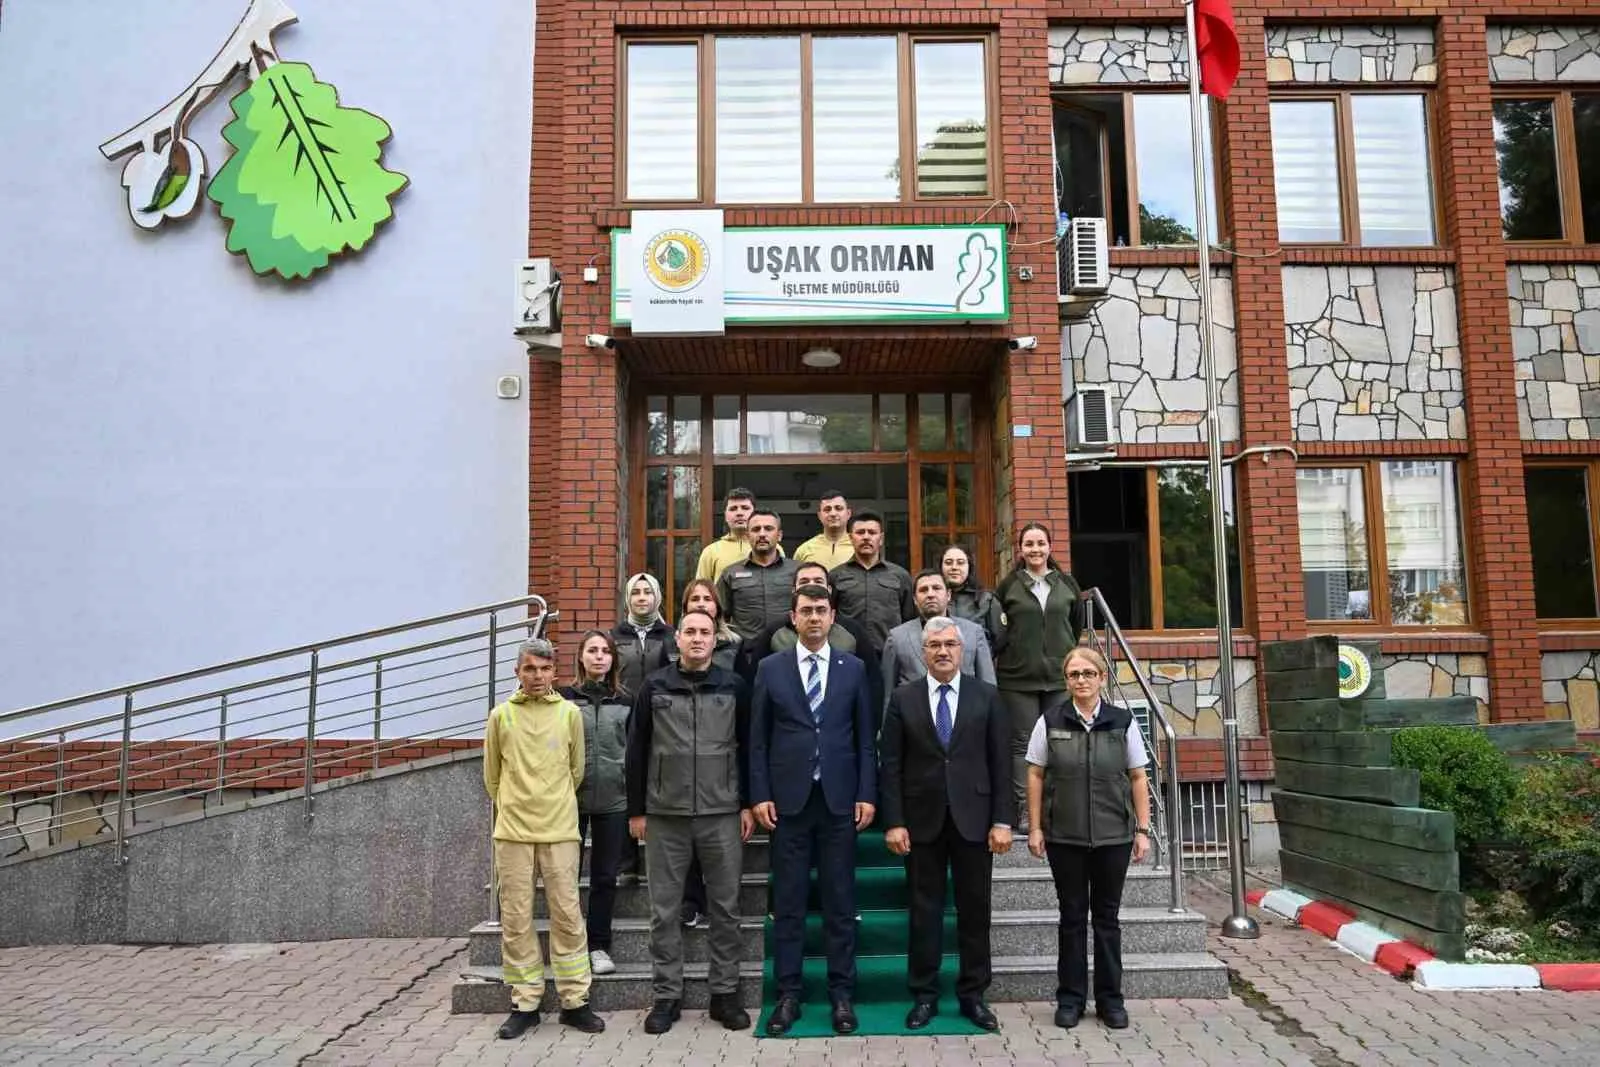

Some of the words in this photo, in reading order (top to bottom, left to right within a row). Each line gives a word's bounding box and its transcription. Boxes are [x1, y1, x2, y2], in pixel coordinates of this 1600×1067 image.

[747, 246, 821, 280] UŞAK
[830, 245, 934, 272] ORMAN
[782, 283, 829, 297] İŞLETME
[832, 280, 900, 295] MÜDÜRLÜĞÜ
